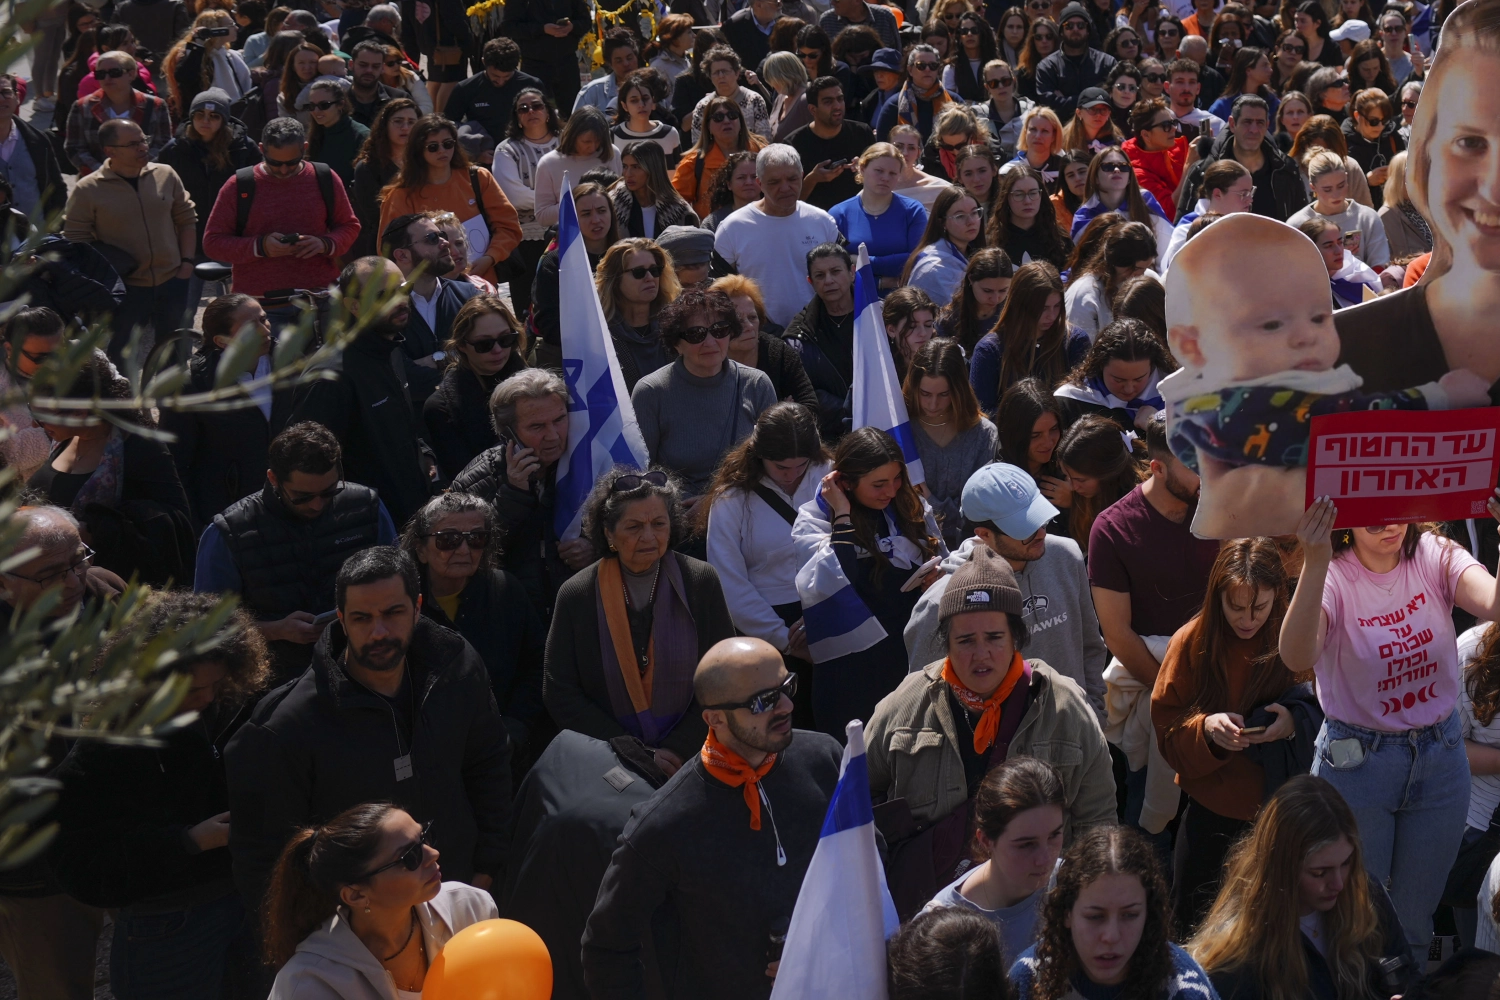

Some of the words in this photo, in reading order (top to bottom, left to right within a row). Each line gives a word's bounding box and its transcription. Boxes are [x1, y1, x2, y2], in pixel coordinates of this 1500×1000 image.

[1324, 435, 1436, 461] החטוף
[1442, 432, 1487, 455] עד
[1340, 466, 1467, 495] האחרון
[1406, 592, 1426, 615] לא
[1358, 608, 1406, 627] עוצרות
[1379, 628, 1434, 659] שכולם
[1389, 624, 1412, 639] עד
[1387, 649, 1428, 677] וכולן
[1378, 661, 1438, 692] חוזרות!
